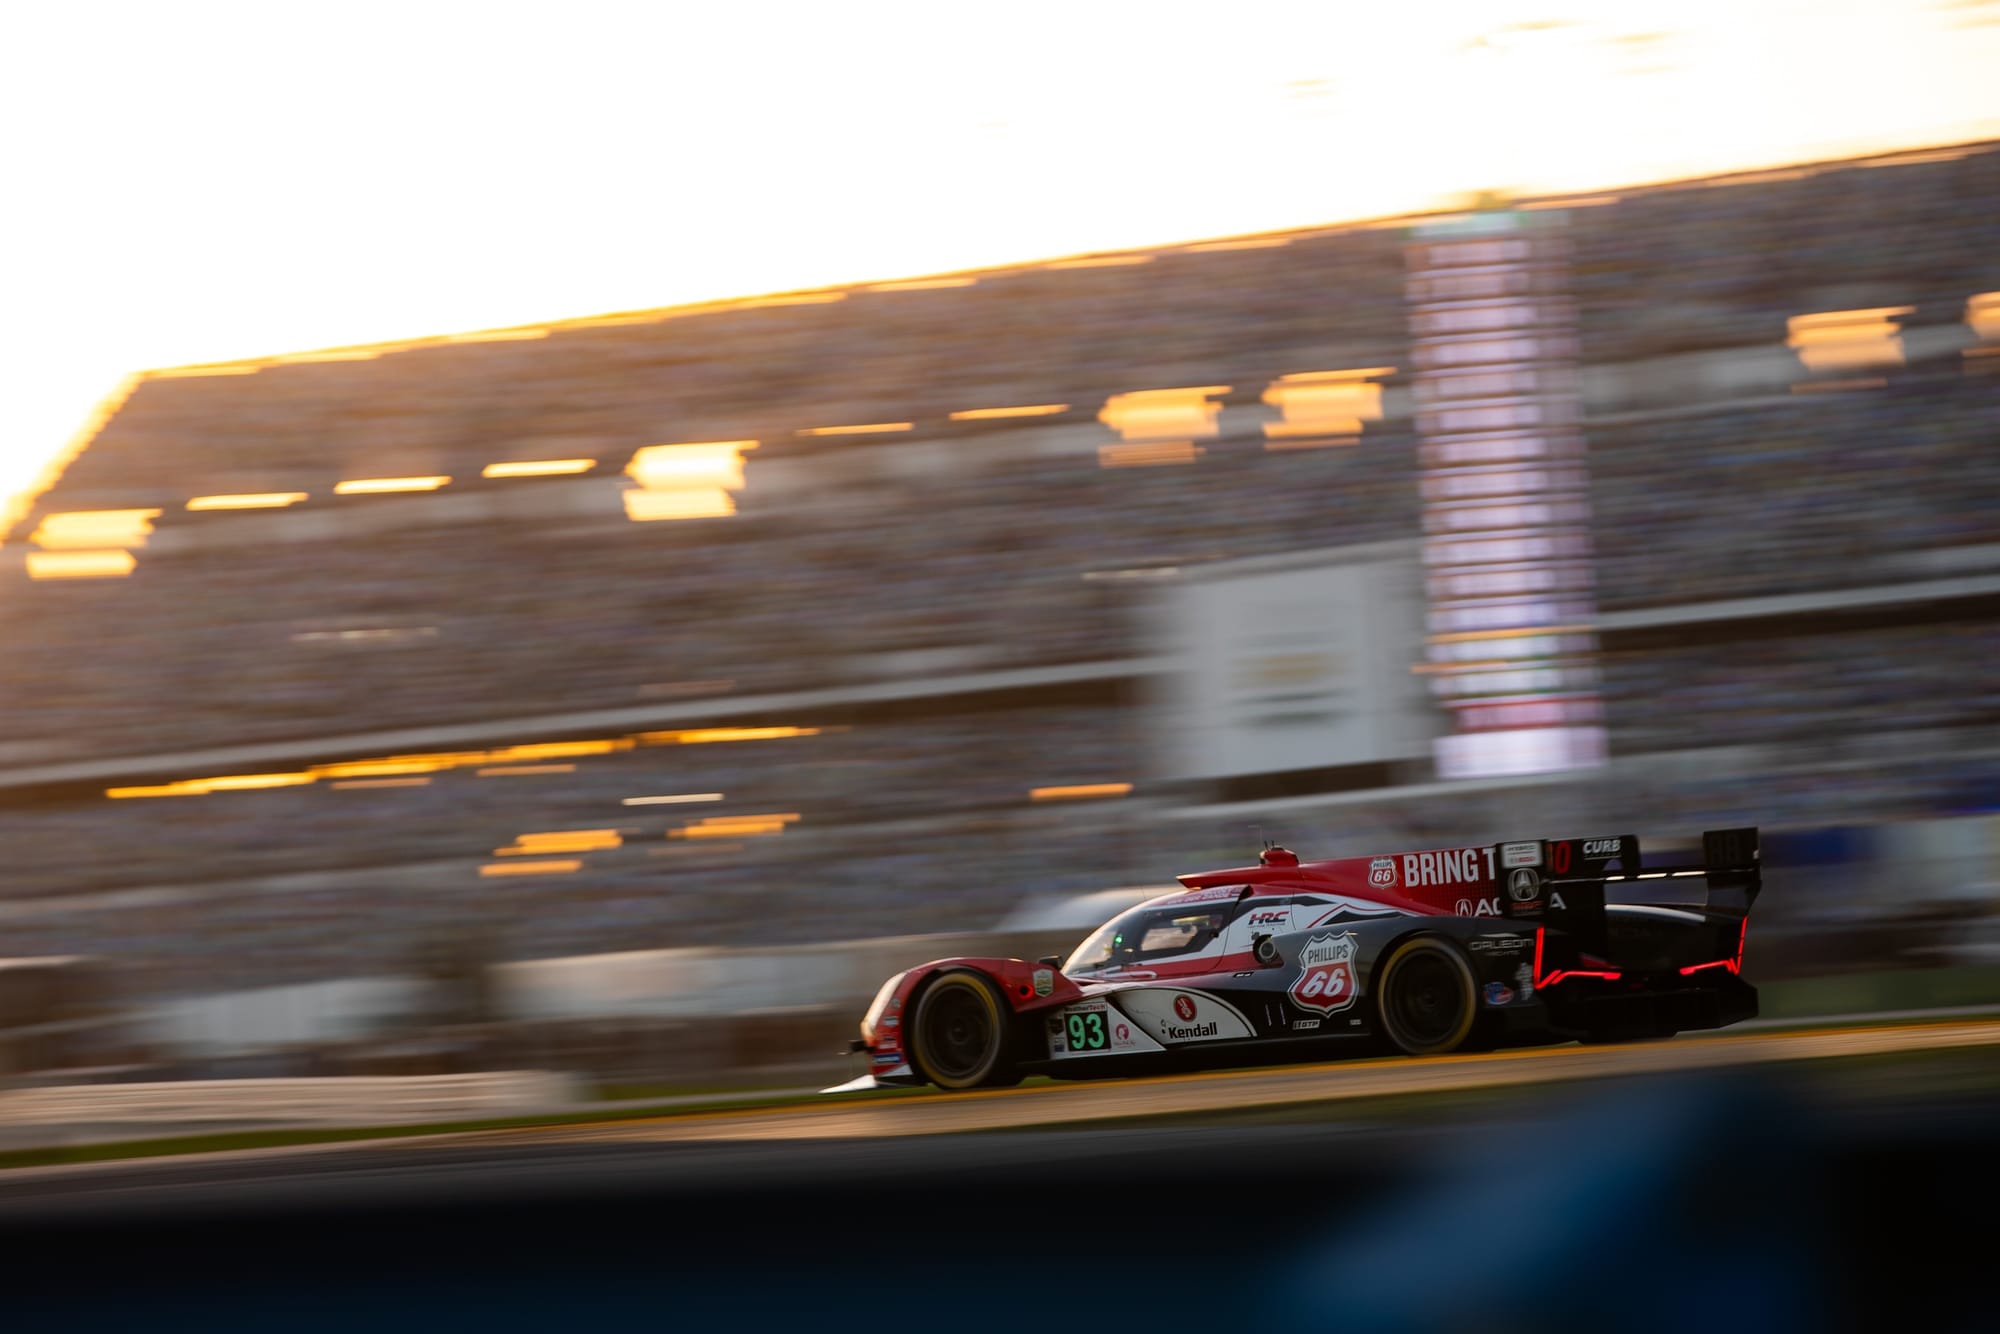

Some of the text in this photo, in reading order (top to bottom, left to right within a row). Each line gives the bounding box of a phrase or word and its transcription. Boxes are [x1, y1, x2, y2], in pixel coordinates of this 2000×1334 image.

[1583, 840, 1621, 854] CURB
[1373, 871, 1392, 883] 66
[1403, 849, 1479, 888] BRING
[1248, 911, 1290, 925] HRC
[1308, 944, 1349, 964] PHILLIPS
[1301, 968, 1346, 998] 66
[1069, 1013, 1105, 1050] 93
[1168, 1021, 1218, 1039] Kendall
